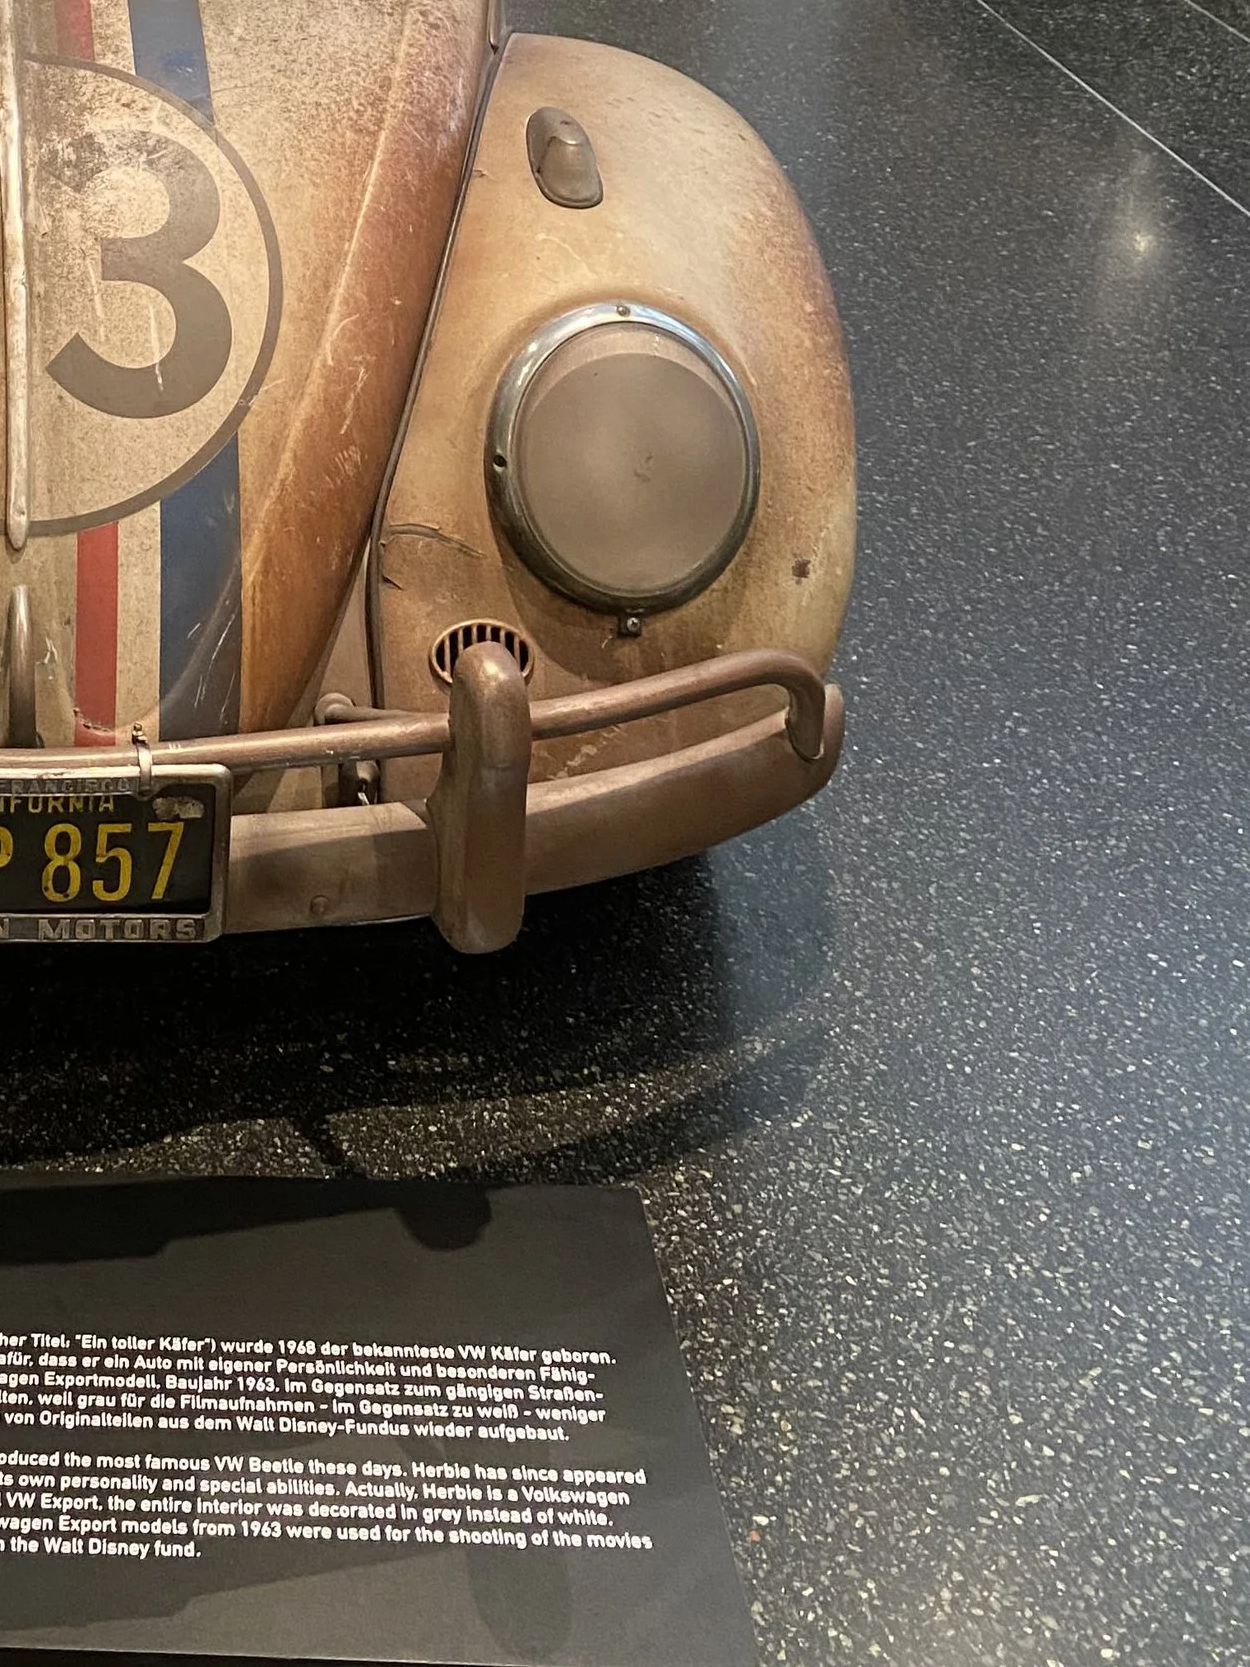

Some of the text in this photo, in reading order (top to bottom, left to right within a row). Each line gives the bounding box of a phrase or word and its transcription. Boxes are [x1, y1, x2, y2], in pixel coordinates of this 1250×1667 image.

[40, 822, 185, 902] 857
[37, 918, 198, 941] MOTORS
[111, 1335, 156, 1351] toller
[220, 1339, 274, 1354] wurde
[277, 1339, 317, 1356] 1968
[352, 1341, 455, 1360] bekannteste
[457, 1344, 486, 1361] VW
[490, 1345, 538, 1363] Käfer
[541, 1347, 617, 1366] geboren.
[38, 1352, 78, 1368] dass
[133, 1354, 173, 1370] Auto
[176, 1355, 205, 1371] mit
[208, 1356, 273, 1375] eigener
[276, 1358, 397, 1377] Persönlichkeit
[399, 1362, 433, 1378] und
[435, 1362, 537, 1381] besonderen
[539, 1366, 596, 1386] Fähig-
[165, 1374, 233, 1394] Baujahr
[311, 1377, 401, 1398] Gegensatz
[445, 1382, 525, 1403] gängigen
[527, 1384, 604, 1403] Straßen-
[37, 1390, 74, 1406] weil
[76, 1394, 116, 1410] grau
[180, 1394, 316, 1413] Filmaufnahmen
[358, 1399, 450, 1419] Gegensatz
[476, 1403, 519, 1420] weiß
[534, 1405, 606, 1425] weniger
[4, 1412, 35, 1425] von
[39, 1409, 154, 1430] Originalteilen
[193, 1414, 232, 1431] dem
[235, 1415, 276, 1432] Walt
[278, 1416, 410, 1438] Disney-Fundus
[413, 1420, 474, 1439] wieder
[477, 1423, 570, 1443] aufgebaut.
[63, 1451, 92, 1468] the
[96, 1454, 141, 1469] most
[144, 1453, 211, 1472] famous
[213, 1455, 244, 1473] VW
[248, 1456, 305, 1474] Beetle
[307, 1458, 357, 1476] these
[361, 1460, 408, 1480] days.
[411, 1461, 471, 1480] Herbie
[511, 1464, 559, 1483] since
[562, 1468, 647, 1486] appeared
[60, 1473, 159, 1495] personality
[199, 1476, 263, 1497] special
[265, 1478, 341, 1497] abilities.
[421, 1482, 483, 1501] Herbie
[520, 1485, 631, 1508] Volkswagen
[5, 1491, 36, 1509] VW
[107, 1494, 137, 1512] the
[140, 1496, 193, 1514] entire
[196, 1496, 264, 1517] interior
[308, 1500, 397, 1520] decorated
[421, 1507, 463, 1525] grey
[465, 1505, 533, 1524] instead
[9, 1535, 40, 1553] the
[43, 1536, 84, 1554] Walt
[88, 1537, 151, 1560] Disney
[153, 1539, 202, 1558] fund.
[58, 1514, 118, 1536] Export
[121, 1517, 189, 1535] models
[192, 1518, 236, 1537] from
[240, 1519, 282, 1538] 1963
[285, 1525, 333, 1540] were
[336, 1524, 382, 1541] used
[414, 1525, 445, 1543] the
[448, 1527, 528, 1548] shooting
[551, 1529, 583, 1548] the
[586, 1531, 653, 1550] movies
